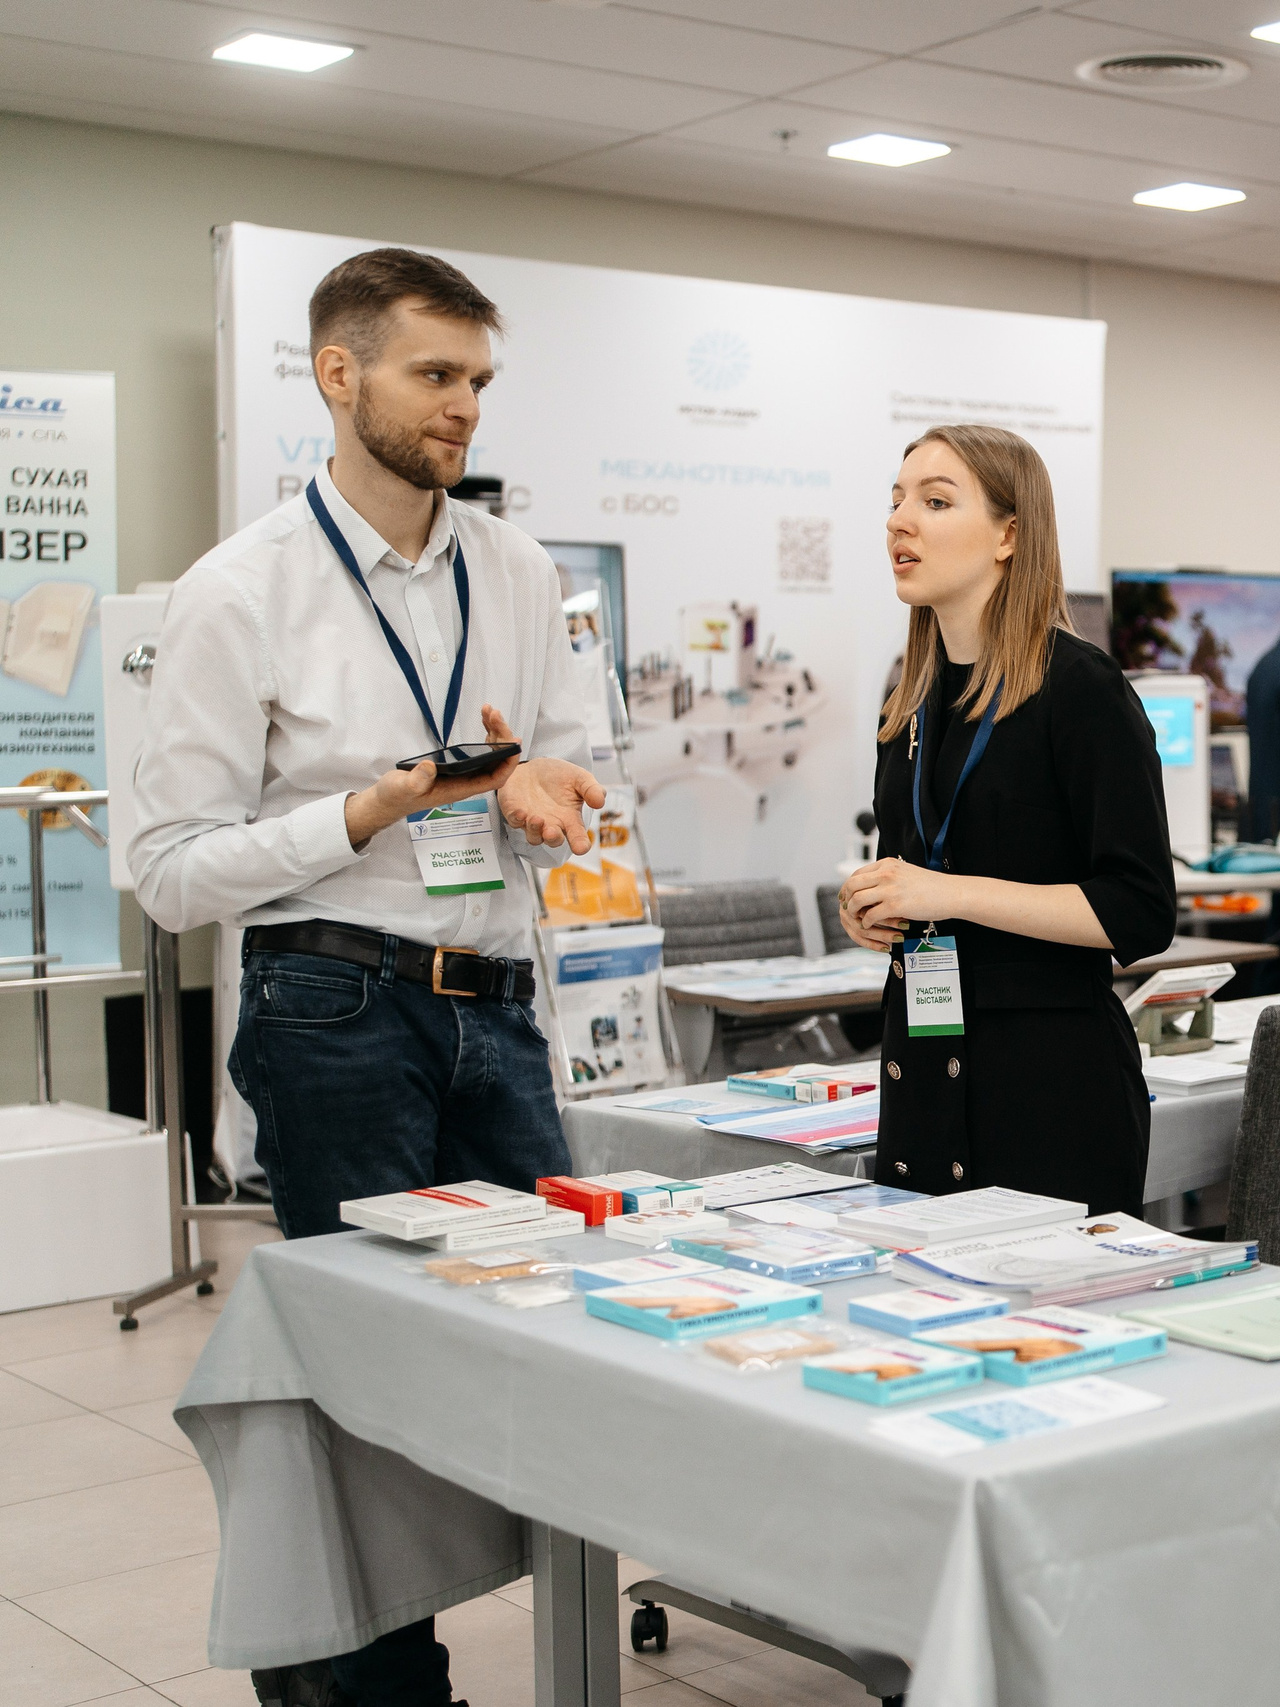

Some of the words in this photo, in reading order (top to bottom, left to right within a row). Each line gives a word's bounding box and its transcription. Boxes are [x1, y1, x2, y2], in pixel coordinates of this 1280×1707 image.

[11, 467, 89, 488] СУХАЯ
[5, 495, 89, 517] ВАННА
[0, 529, 89, 563] ЗЕР
[430, 847, 482, 860] УЧАСТНИК
[431, 856, 485, 868] ВЫСТАВКИ
[915, 985, 952, 996] УЧАСТНИК
[915, 995, 953, 1005] ВЫСТАВКИ
